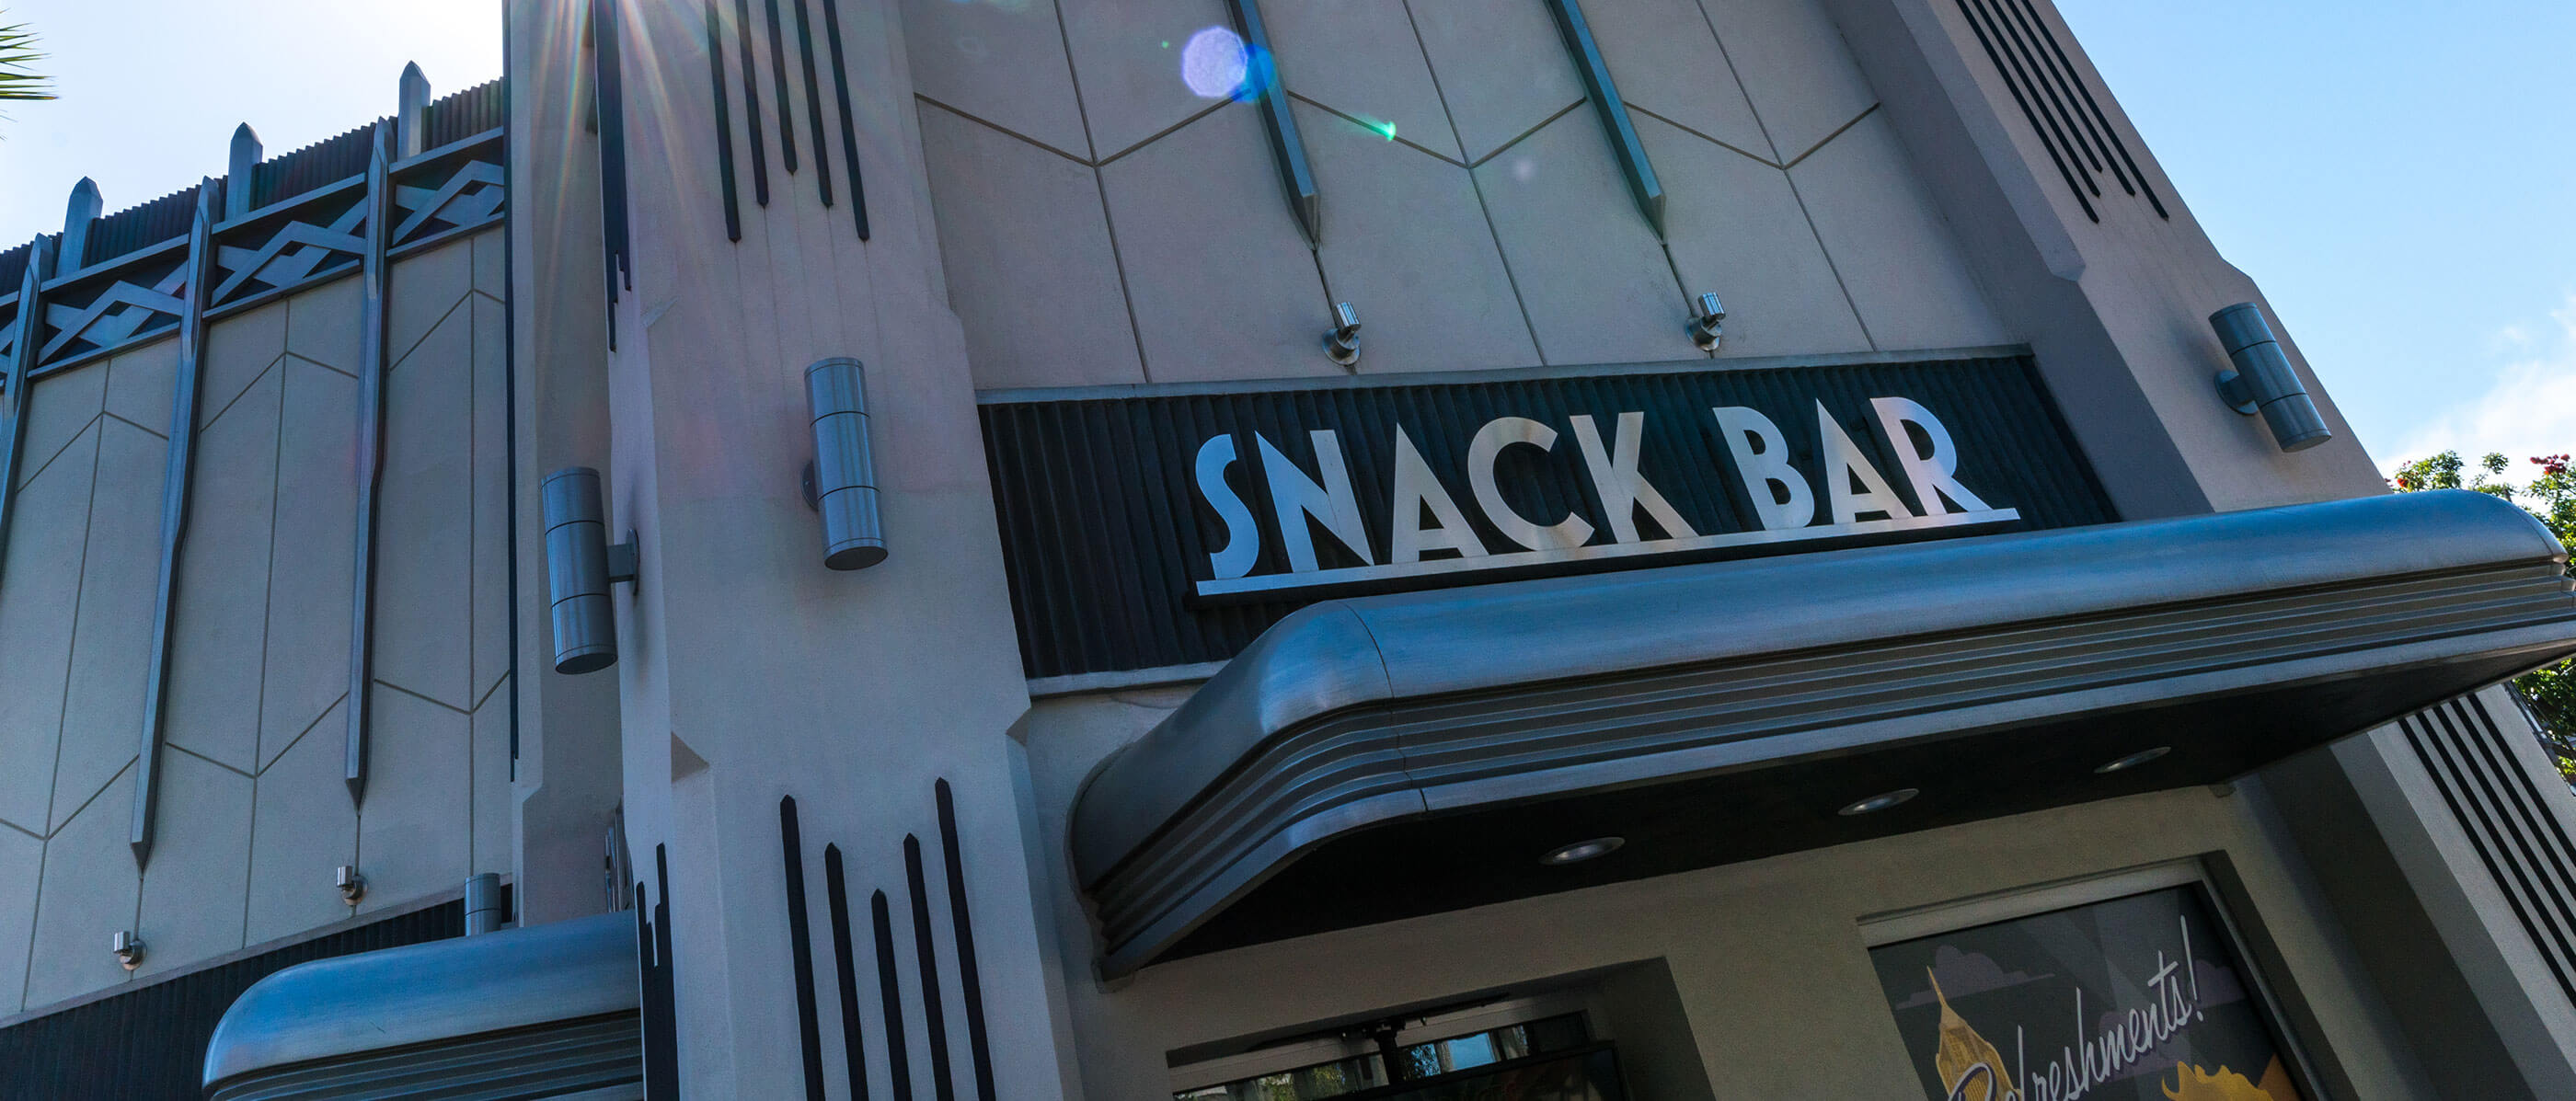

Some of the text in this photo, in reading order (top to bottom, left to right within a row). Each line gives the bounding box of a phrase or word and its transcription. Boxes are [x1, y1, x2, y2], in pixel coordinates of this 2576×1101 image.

[1195, 396, 1994, 579] SNACK BAR
[1947, 915, 2203, 1101] freshments!
